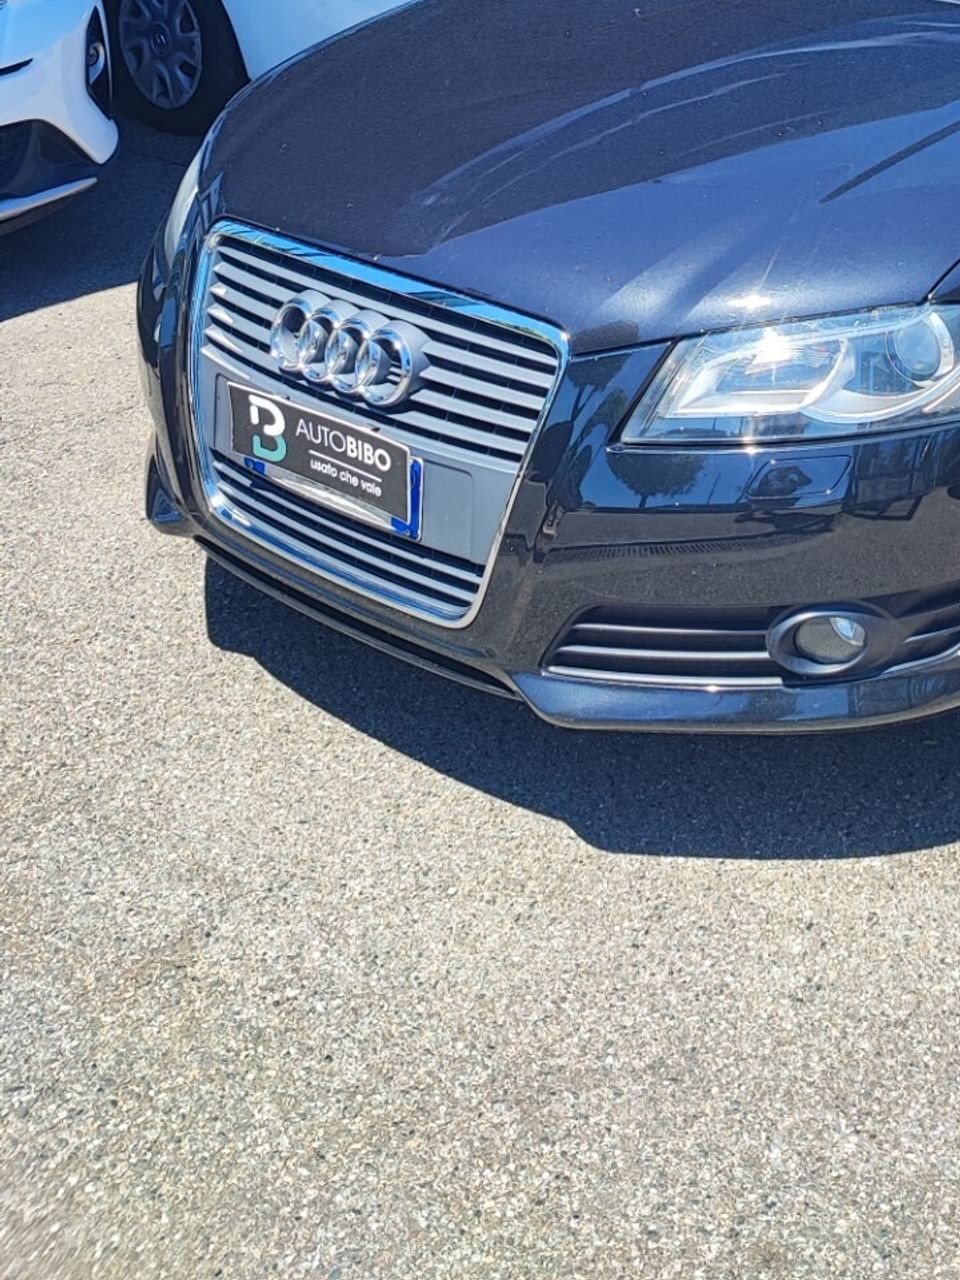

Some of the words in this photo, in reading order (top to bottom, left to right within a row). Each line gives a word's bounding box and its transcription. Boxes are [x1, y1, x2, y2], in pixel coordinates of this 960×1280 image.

[295, 419, 391, 471] AUTOBIBO
[310, 459, 338, 478] usato
[339, 470, 359, 487] che
[360, 480, 382, 497] vale
